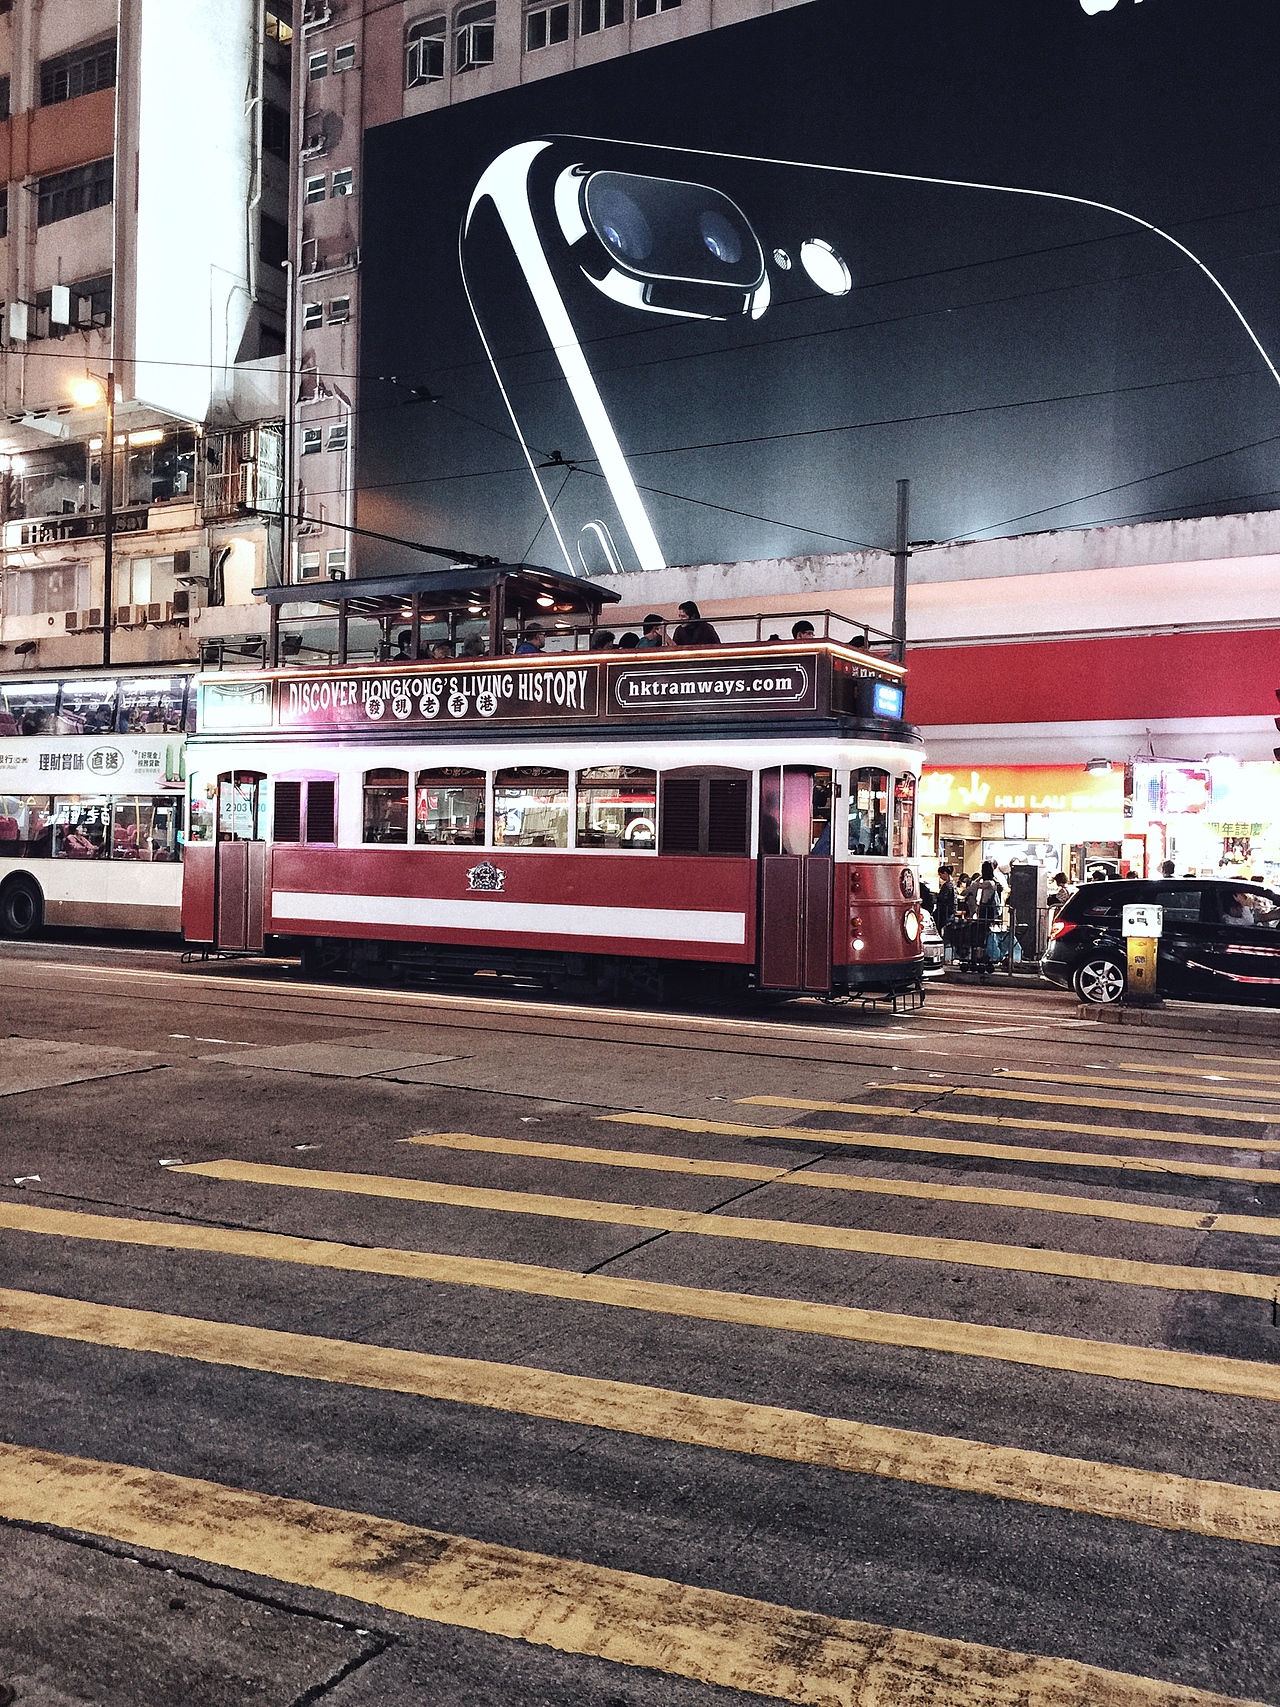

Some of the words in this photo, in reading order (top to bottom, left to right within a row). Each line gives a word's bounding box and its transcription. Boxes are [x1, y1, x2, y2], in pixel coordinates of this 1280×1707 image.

[289, 681, 358, 716] DISCOVER
[462, 674, 514, 698] LIVING
[518, 670, 588, 710] HISTORY
[628, 677, 793, 696] hktramways.com
[367, 694, 495, 716] 發現老香港
[994, 795, 1025, 808] HUI
[1030, 795, 1066, 808] LAU
